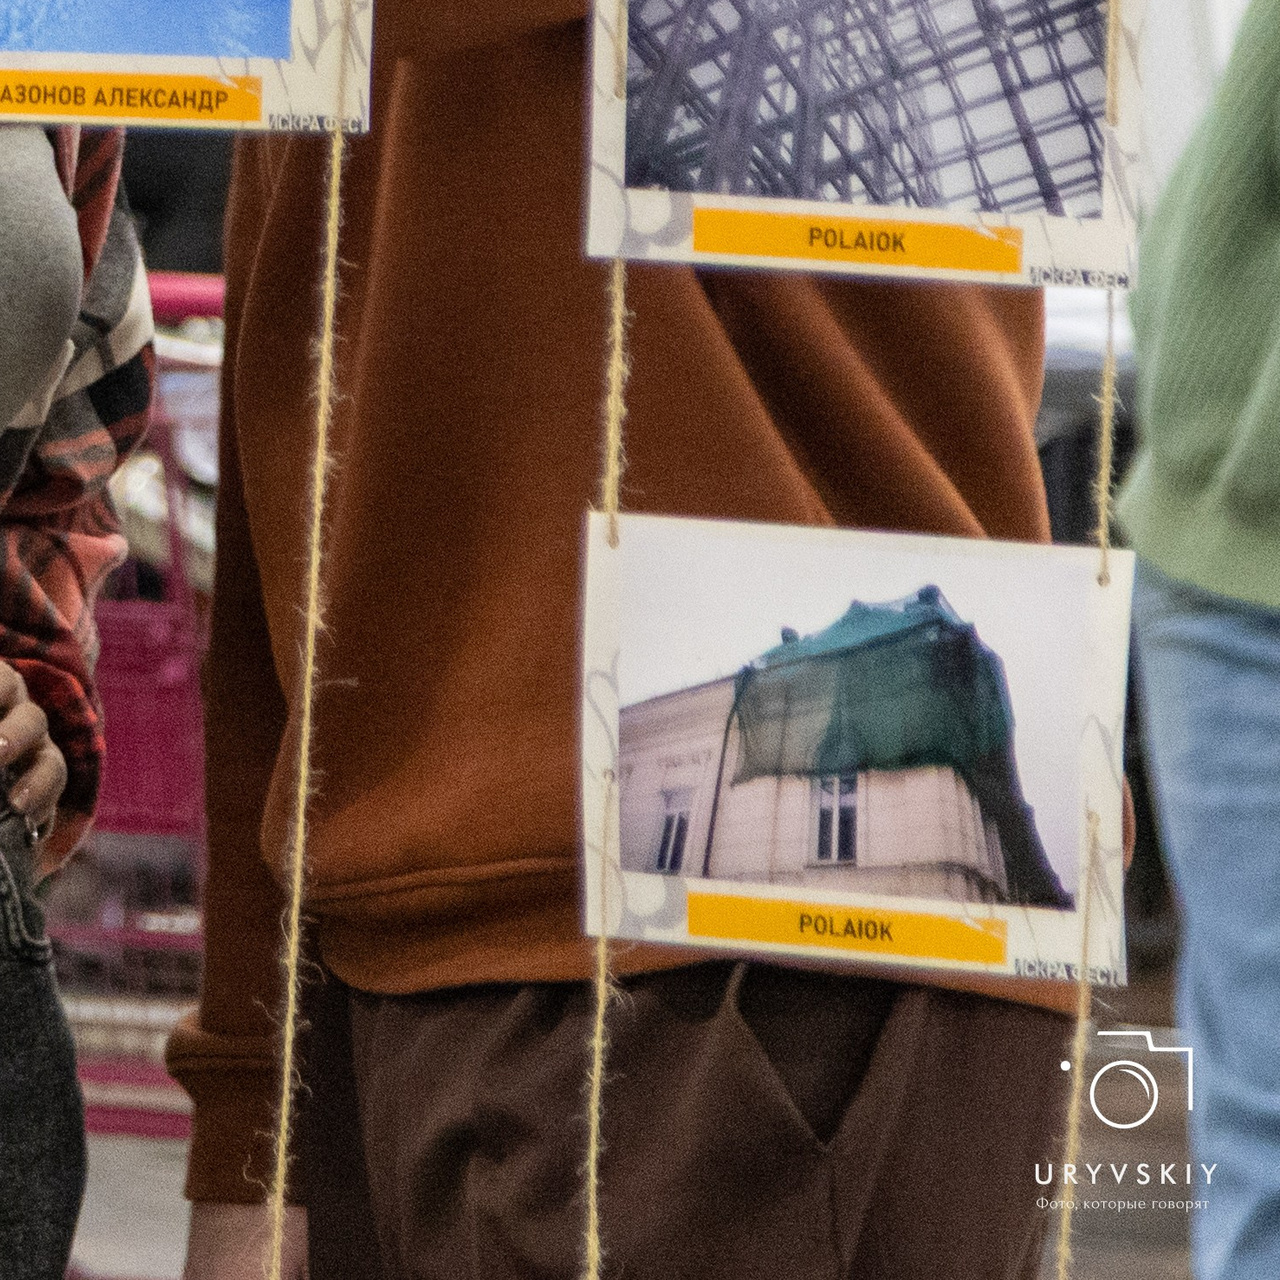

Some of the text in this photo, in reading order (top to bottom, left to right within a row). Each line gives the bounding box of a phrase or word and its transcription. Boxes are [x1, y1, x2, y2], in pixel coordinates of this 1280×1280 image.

[93, 86, 229, 114] АЛЕКСАНДР
[269, 113, 320, 132] ИСКРА
[808, 226, 906, 253] POLAIOK
[799, 912, 894, 942] POLAIOK
